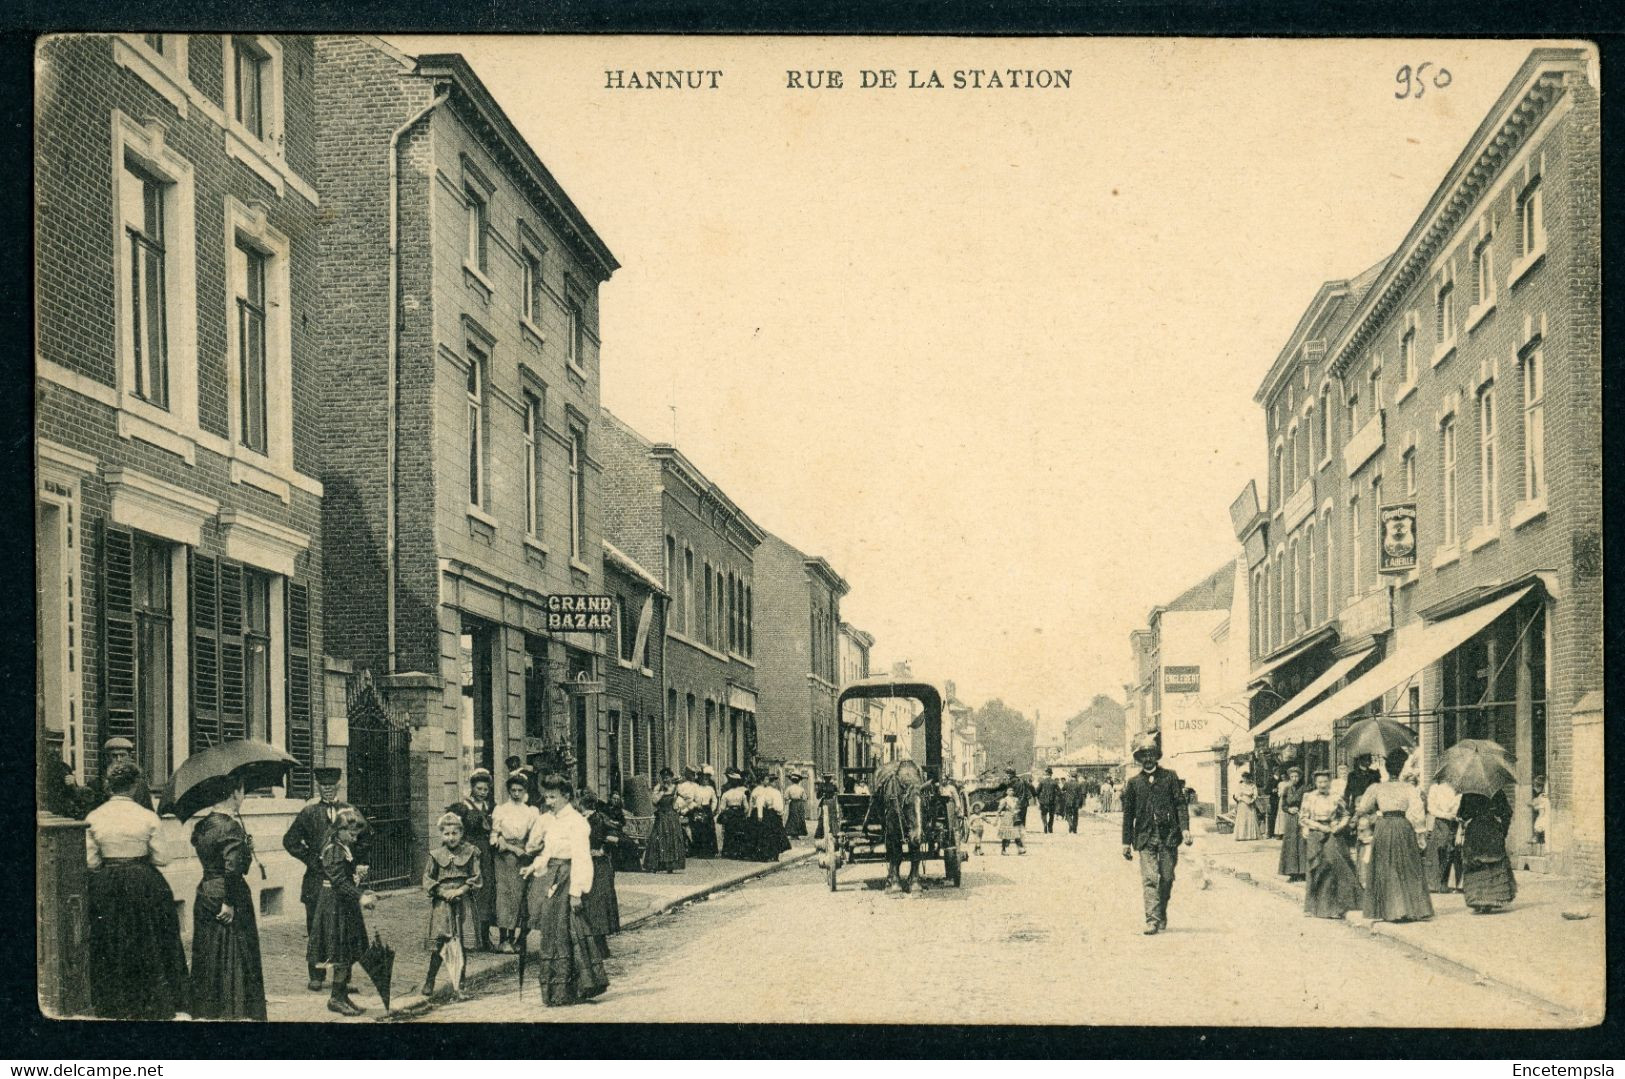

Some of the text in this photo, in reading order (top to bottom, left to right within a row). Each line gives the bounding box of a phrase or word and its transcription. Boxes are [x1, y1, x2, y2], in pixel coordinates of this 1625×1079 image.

[1395, 62, 1452, 99] 950
[548, 596, 612, 613] GRAND
[548, 613, 612, 630] BAZAR
